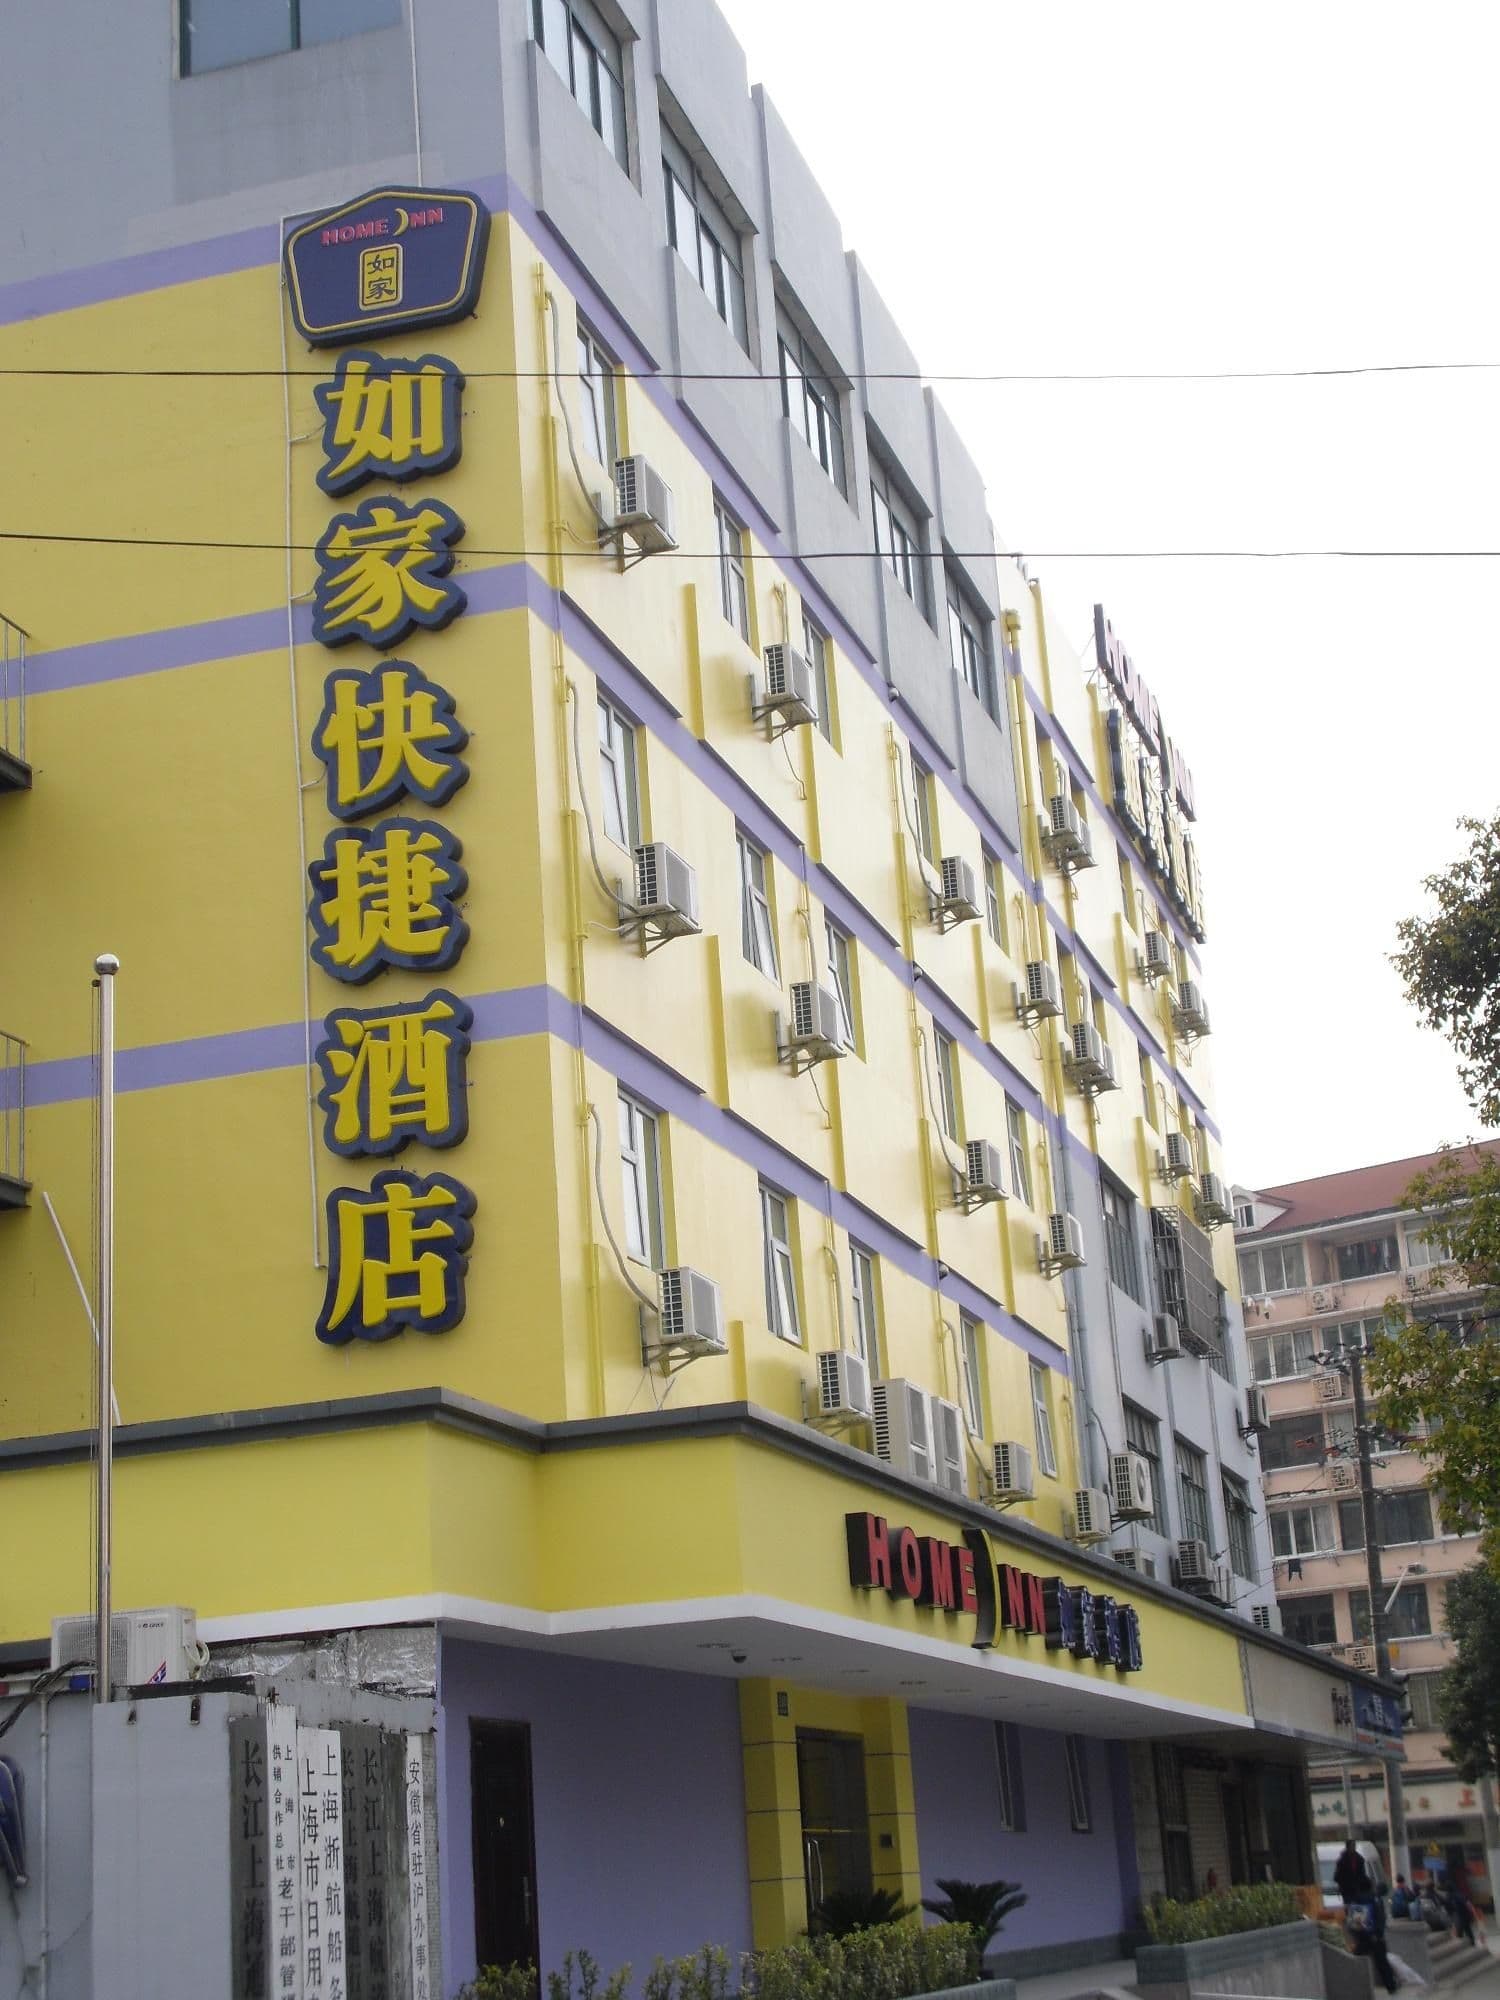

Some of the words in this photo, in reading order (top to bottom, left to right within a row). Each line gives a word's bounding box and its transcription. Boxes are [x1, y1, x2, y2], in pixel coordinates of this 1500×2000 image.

[321, 219, 390, 245] HOME
[365, 253, 396, 301] 如家
[325, 359, 458, 1331] 如家快捷酒店
[846, 1512, 978, 1615] HOME
[301, 1758, 321, 2000] 上海市日用
